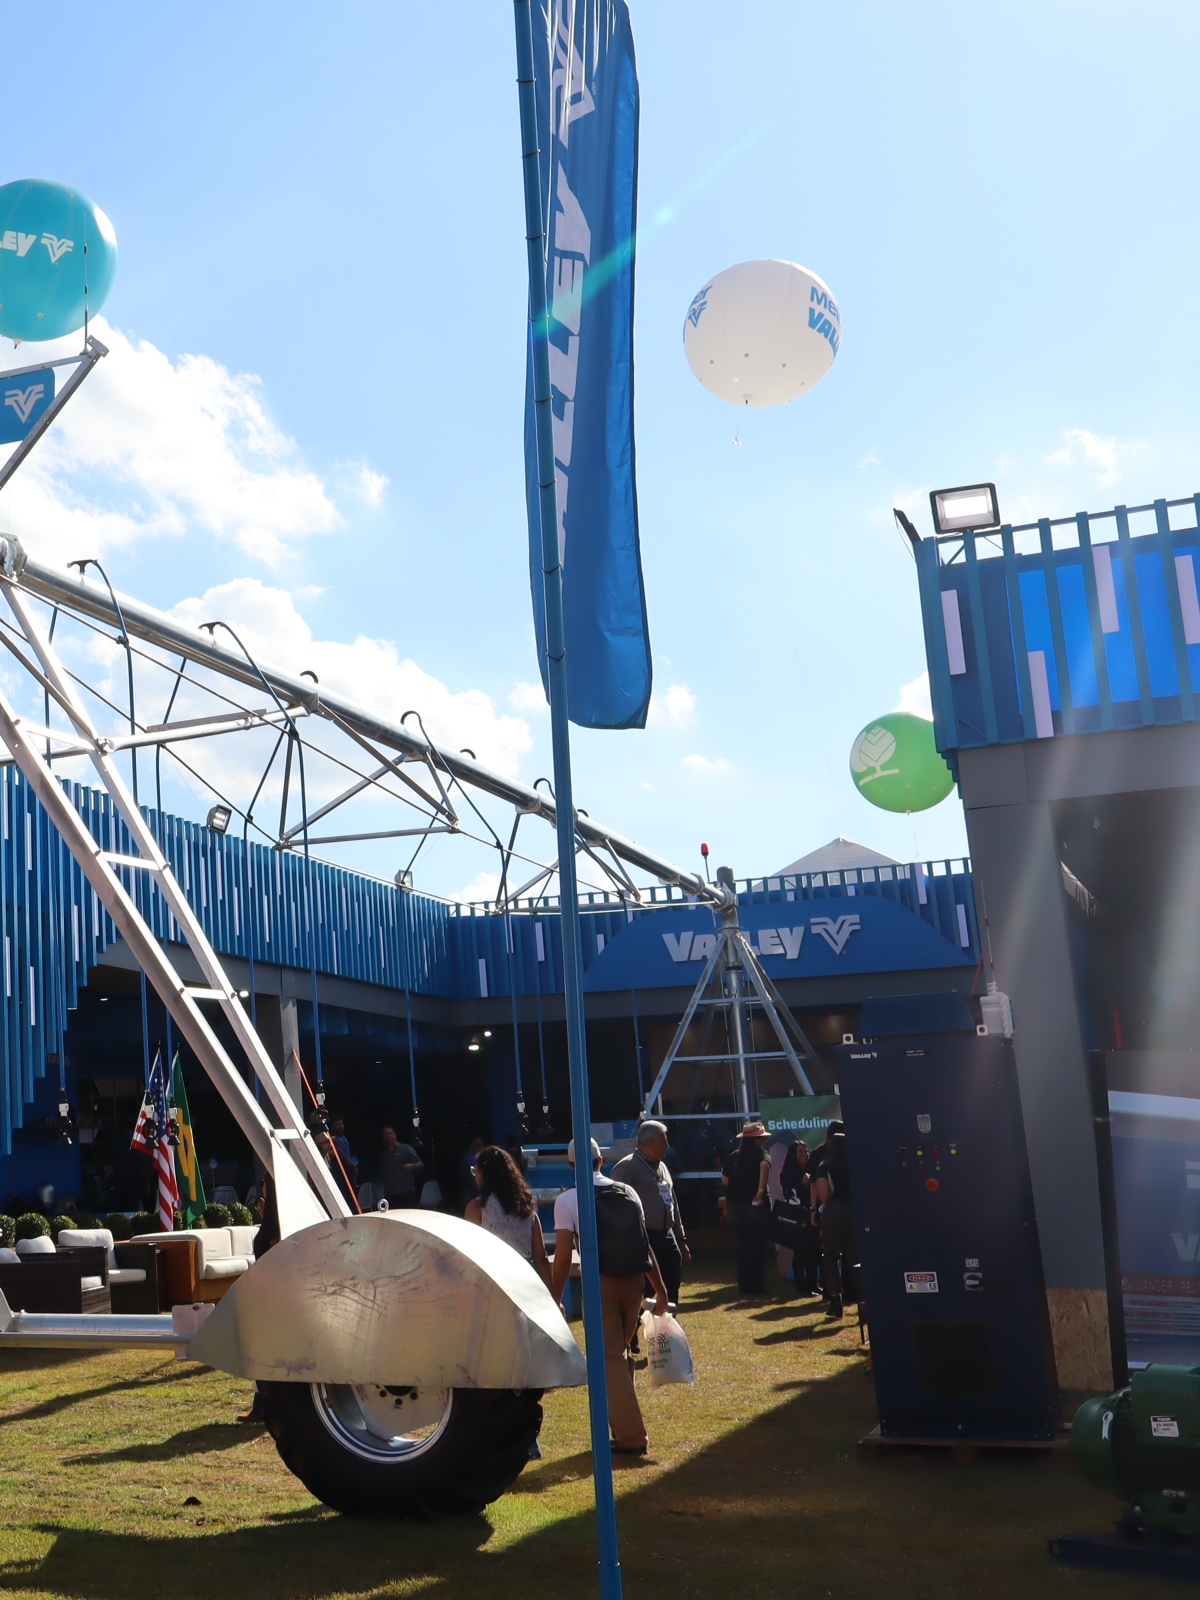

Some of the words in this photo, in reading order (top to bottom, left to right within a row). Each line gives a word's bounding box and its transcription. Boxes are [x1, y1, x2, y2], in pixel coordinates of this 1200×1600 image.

[809, 286, 840, 324] Me
[551, 161, 592, 570] LLEY
[1136, 1279, 1174, 1293] DANGER
